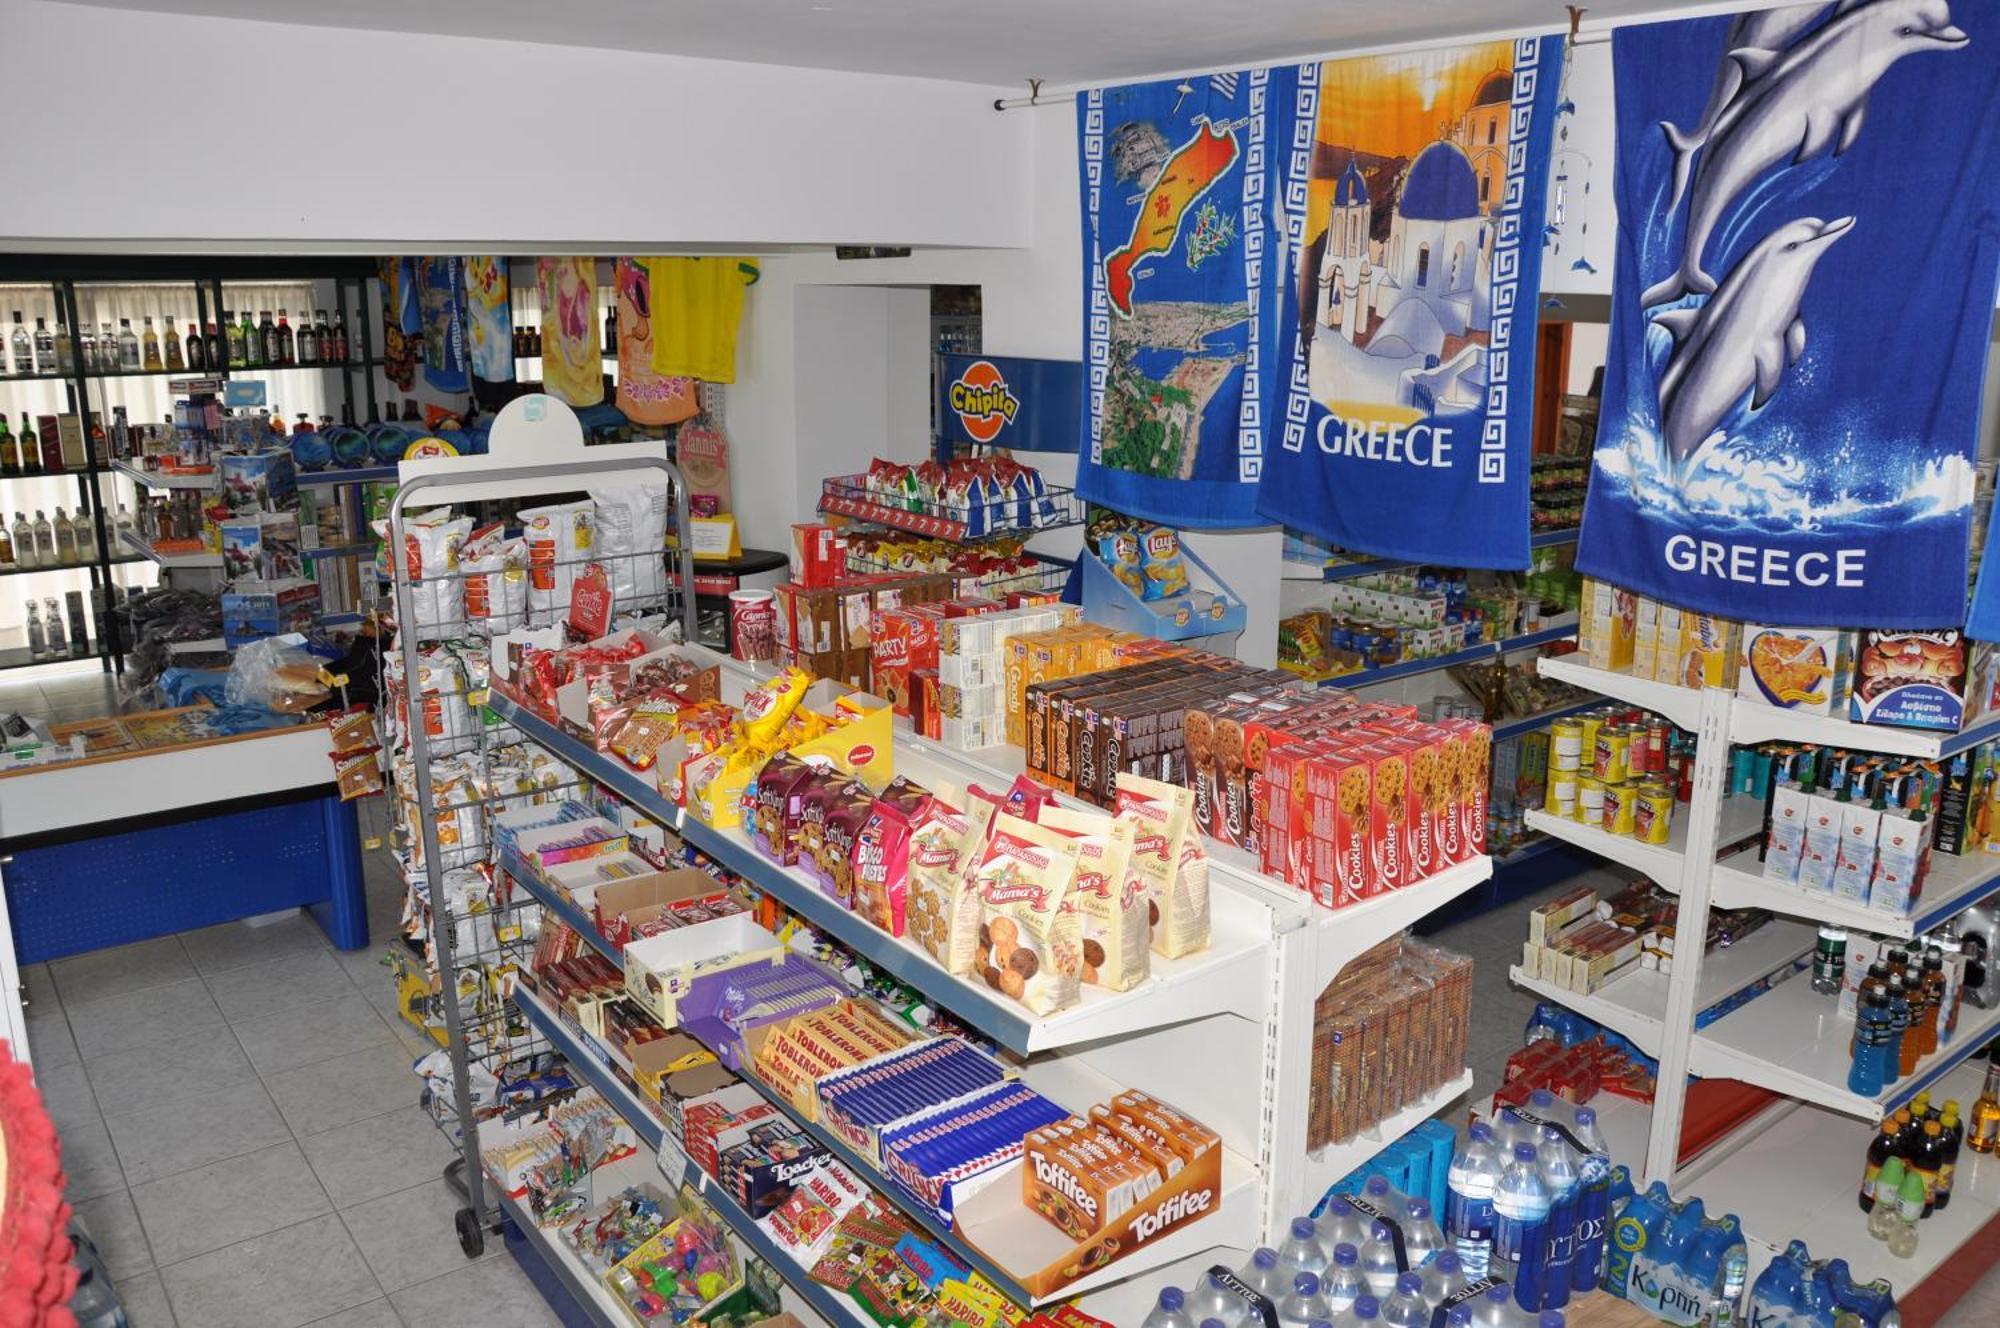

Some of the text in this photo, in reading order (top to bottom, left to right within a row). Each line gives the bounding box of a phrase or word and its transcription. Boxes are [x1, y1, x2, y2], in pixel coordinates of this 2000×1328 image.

[1316, 413, 1453, 468] GREECE
[1151, 535, 1176, 553] Lay's
[1664, 534, 1867, 588] GREECE
[872, 637, 908, 658] PARTY
[1196, 769, 1211, 824] Cookies
[1226, 779, 1241, 835] Cookies
[1471, 791, 1483, 844] Cookies
[1384, 822, 1399, 879] Cookies
[1417, 811, 1432, 867] Cookies
[1446, 801, 1458, 854] Cookies
[1349, 832, 1364, 890] Cookies
[991, 886, 1040, 900] Mama's
[775, 1035, 828, 1078] TOBLERON
[797, 1029, 845, 1069] TOBLERON
[810, 1020, 868, 1061] TOBLERONE
[825, 1106, 870, 1151] CRUNCH
[771, 1153, 833, 1183] Loacker
[809, 1177, 842, 1209] HARIBO
[887, 1150, 945, 1208] CRUNCH
[1030, 1151, 1099, 1218] Toffifee
[1129, 1188, 1213, 1242] Toffifee
[944, 1295, 986, 1328] HARIBO
